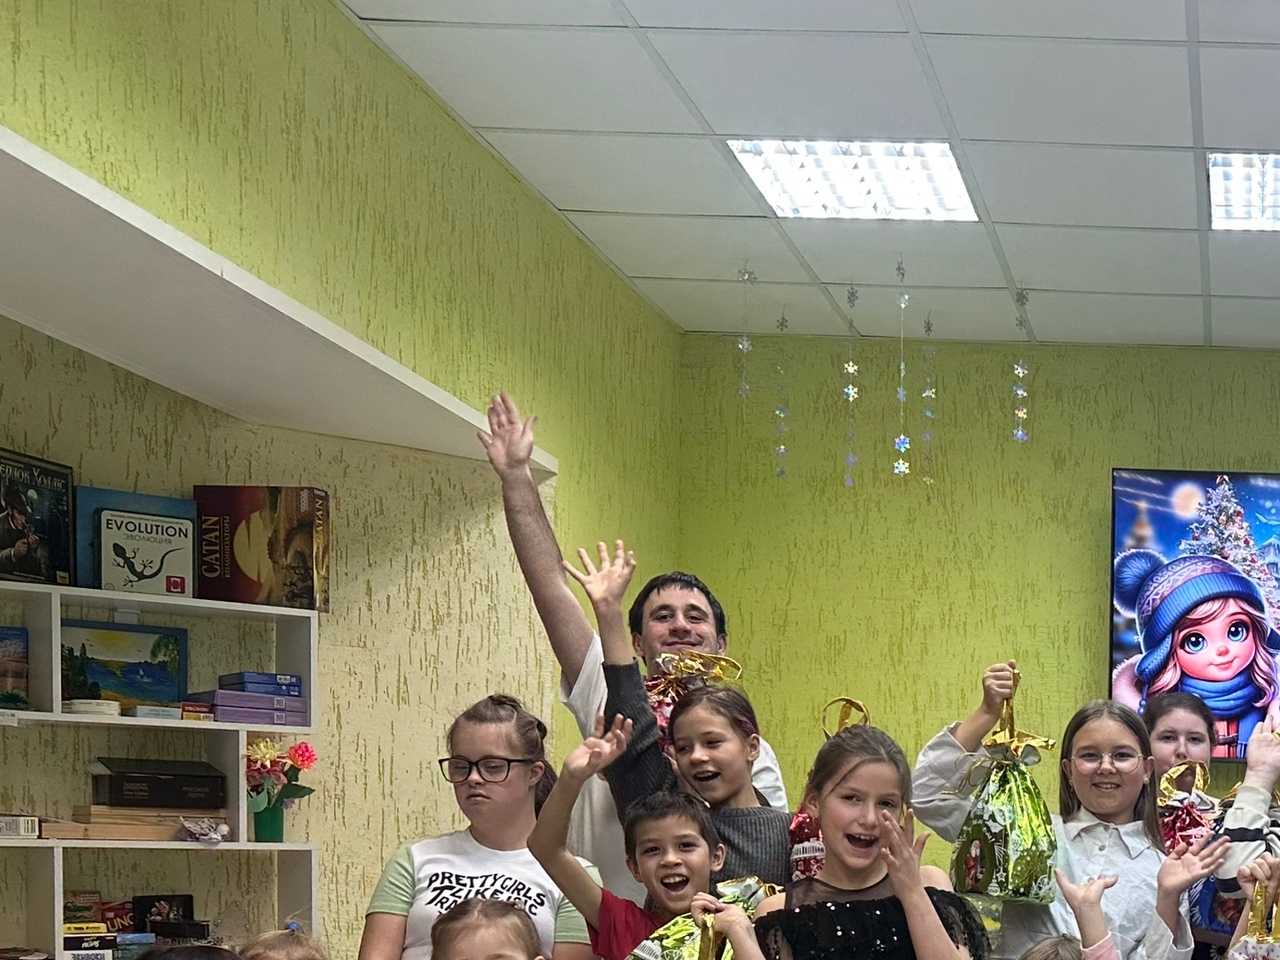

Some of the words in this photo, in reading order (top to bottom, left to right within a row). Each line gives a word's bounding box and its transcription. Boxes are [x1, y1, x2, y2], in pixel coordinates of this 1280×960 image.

[106, 518, 188, 539] EVOLUTION
[201, 514, 221, 579] CATAN
[425, 884, 458, 911] TRA
[427, 871, 505, 889] PRETTY
[500, 876, 546, 907] GIRLS
[449, 887, 504, 901] LIKE
